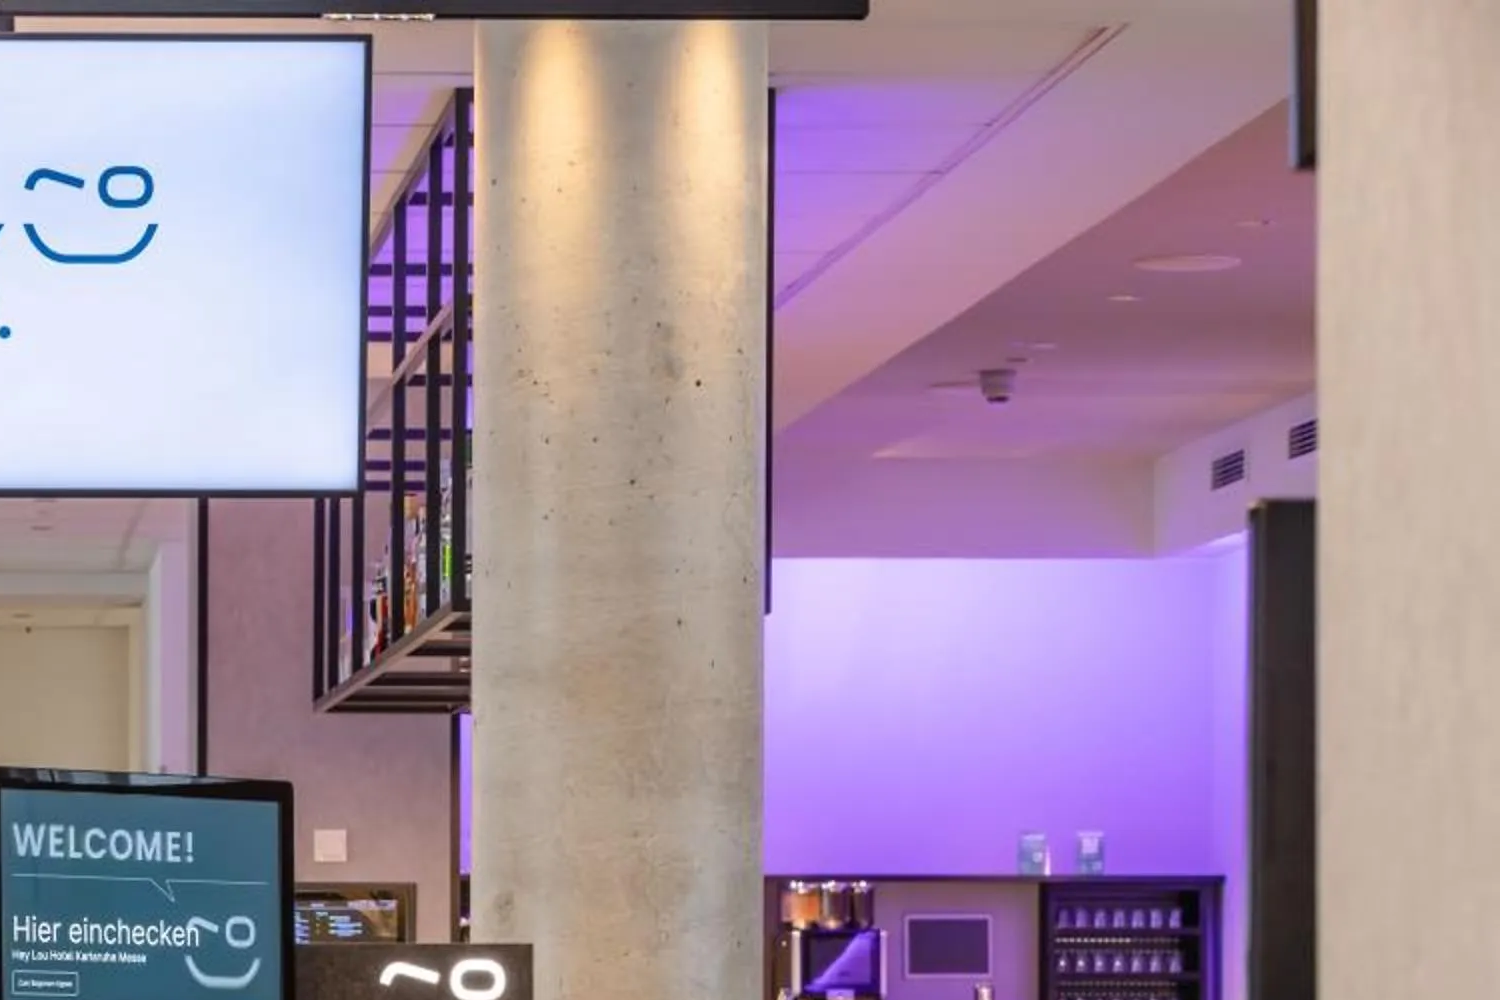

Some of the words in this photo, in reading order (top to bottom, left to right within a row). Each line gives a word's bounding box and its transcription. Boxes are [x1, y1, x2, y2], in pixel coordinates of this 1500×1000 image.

[12, 822, 194, 864] WELCOME!
[13, 915, 62, 943] Hier
[68, 917, 200, 947] einchecken
[31, 950, 49, 962] Lou
